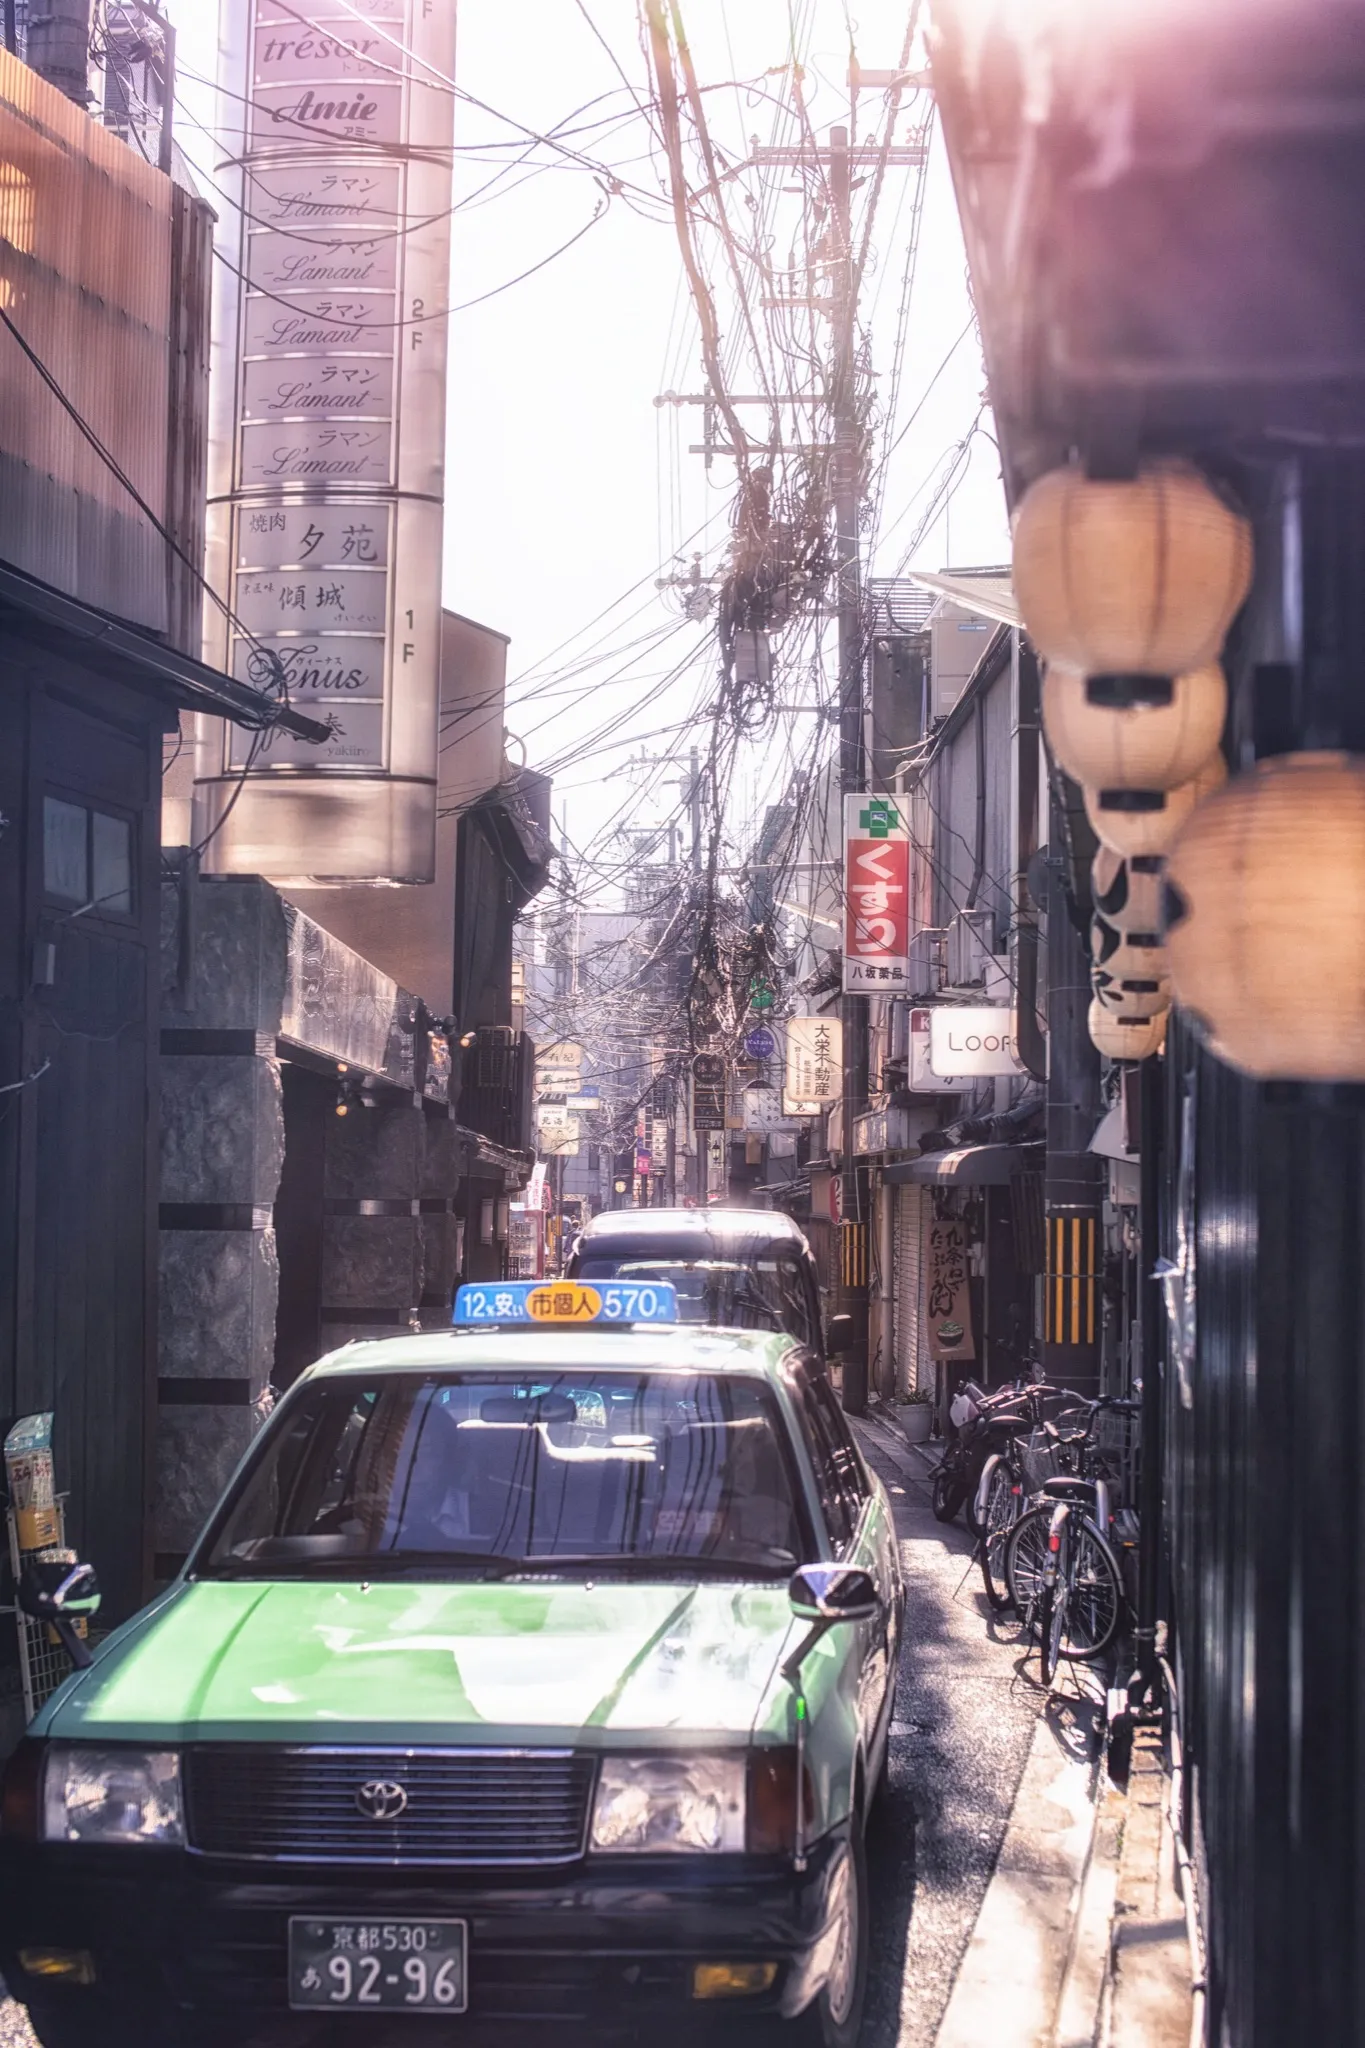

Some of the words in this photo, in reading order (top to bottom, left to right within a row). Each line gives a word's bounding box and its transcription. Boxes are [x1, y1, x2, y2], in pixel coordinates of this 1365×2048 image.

[263, 31, 379, 62] trésor
[272, 91, 377, 122] Amie
[344, 126, 377, 137] アミー
[320, 176, 380, 192] ラマン
[316, 302, 373, 319] ラマン
[321, 366, 380, 384] ラマン
[318, 430, 382, 447] ラマン
[250, 512, 286, 533] 焼肉
[279, 582, 345, 611] 傾城
[852, 843, 903, 953] くすり
[852, 966, 903, 980] 八坂薬品
[814, 1024, 830, 1096] 大栄不動産
[532, 1292, 594, 1316] 市個人
[328, 1955, 456, 2003] 92-96
